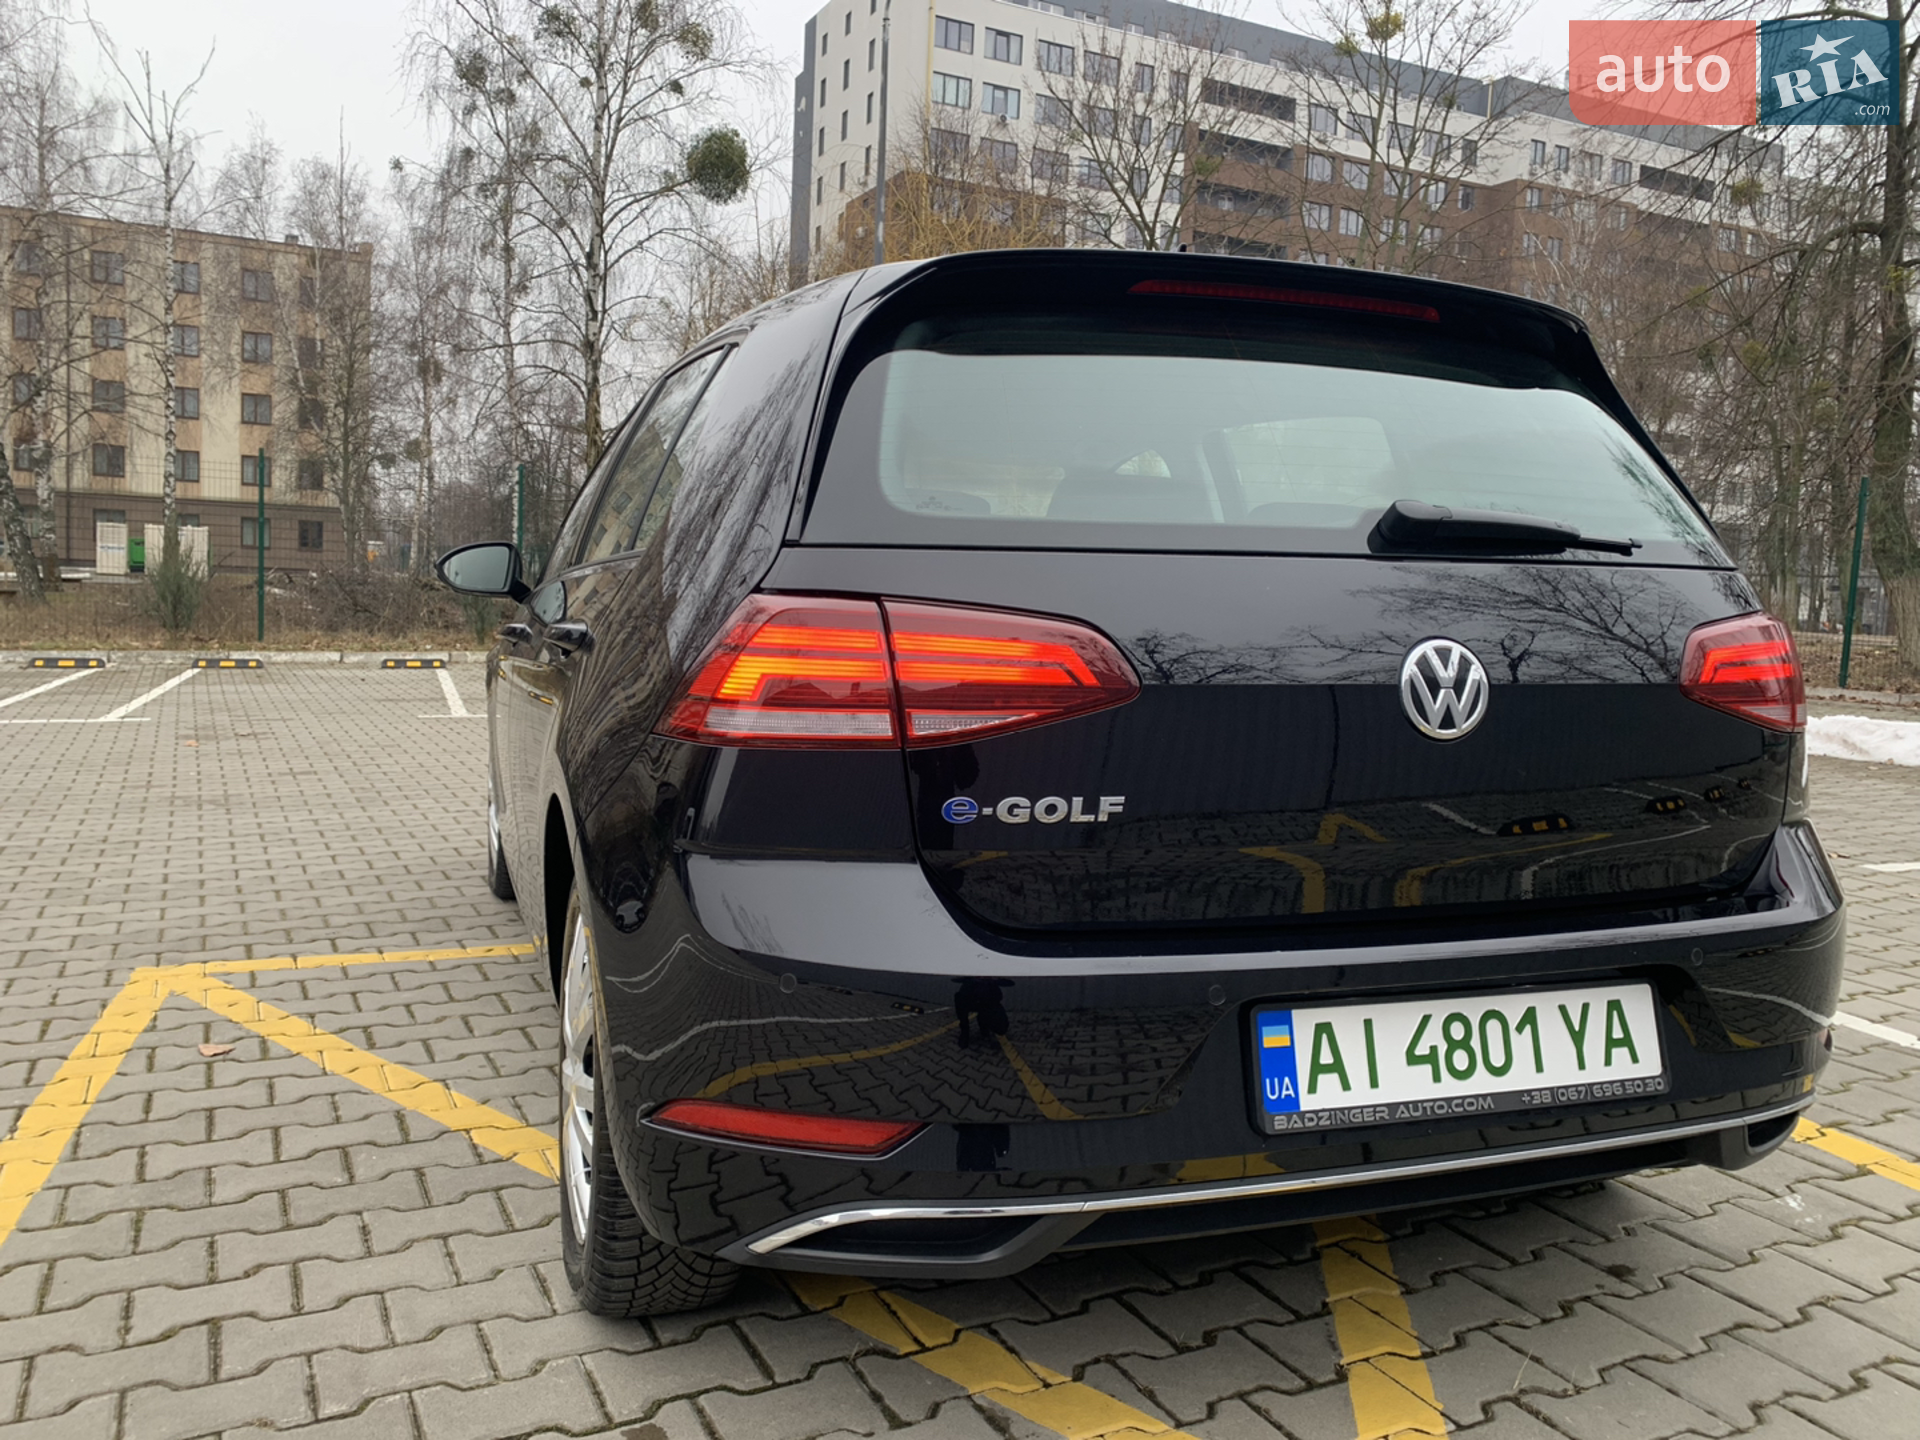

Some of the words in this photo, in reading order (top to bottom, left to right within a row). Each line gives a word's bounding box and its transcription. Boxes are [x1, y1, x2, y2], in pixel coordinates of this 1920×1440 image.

[941, 796, 1126, 824] e-GOLF
[1307, 1018, 1379, 1095] AI
[1405, 1006, 1544, 1084] 4801
[1558, 999, 1640, 1071] YA
[1266, 1076, 1296, 1100] UA
[1521, 1090, 1552, 1105] +38
[1553, 1083, 1591, 1105] (067)
[1593, 1082, 1623, 1097] 696
[1273, 1106, 1390, 1130] BADZINGER
[1395, 1096, 1495, 1119] AUTO.COM
